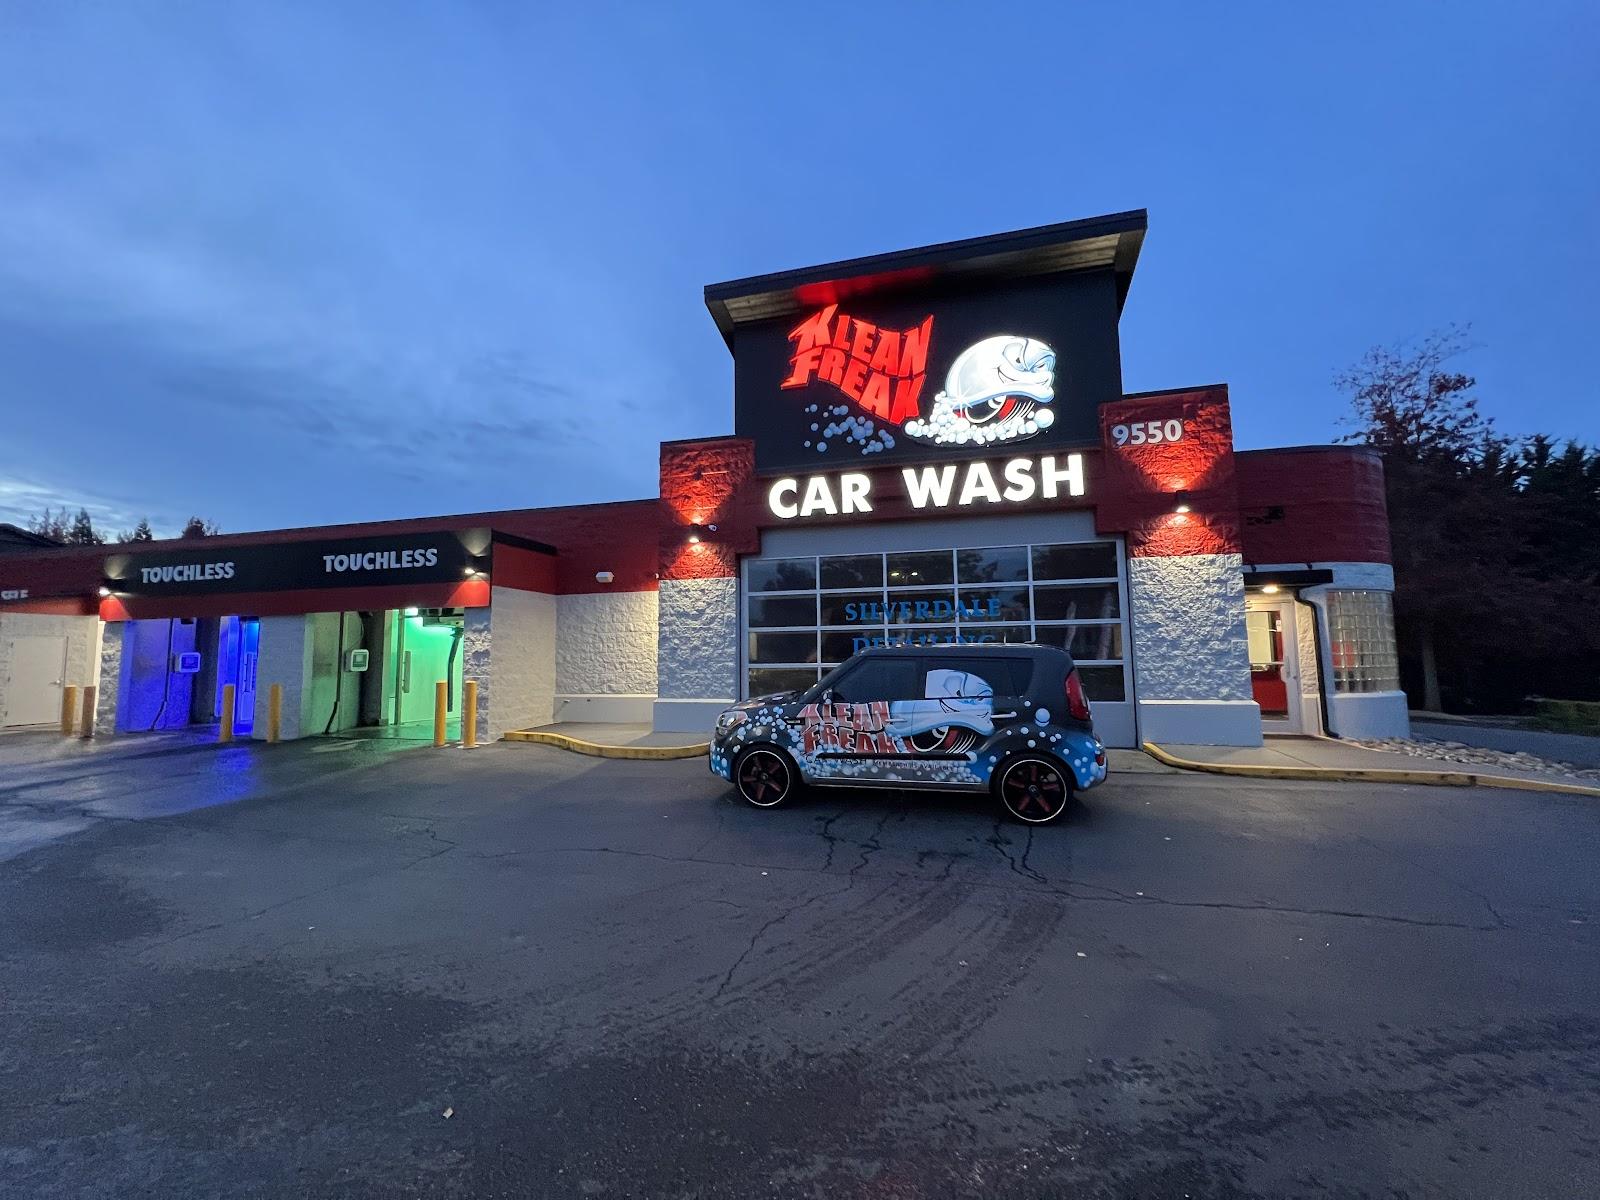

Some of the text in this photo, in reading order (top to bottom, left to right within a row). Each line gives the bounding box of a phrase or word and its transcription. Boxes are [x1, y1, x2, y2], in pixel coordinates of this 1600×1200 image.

[788, 303, 934, 378] KLEAN
[780, 346, 927, 425] FREAK
[1111, 419, 1182, 447] 9550
[768, 454, 1085, 519] CAR WASH
[141, 562, 235, 584] TOUCHLESS
[323, 548, 438, 573] TOUCHLESS
[844, 597, 1002, 621] SILVERDALE
[797, 701, 891, 732] KLEAN
